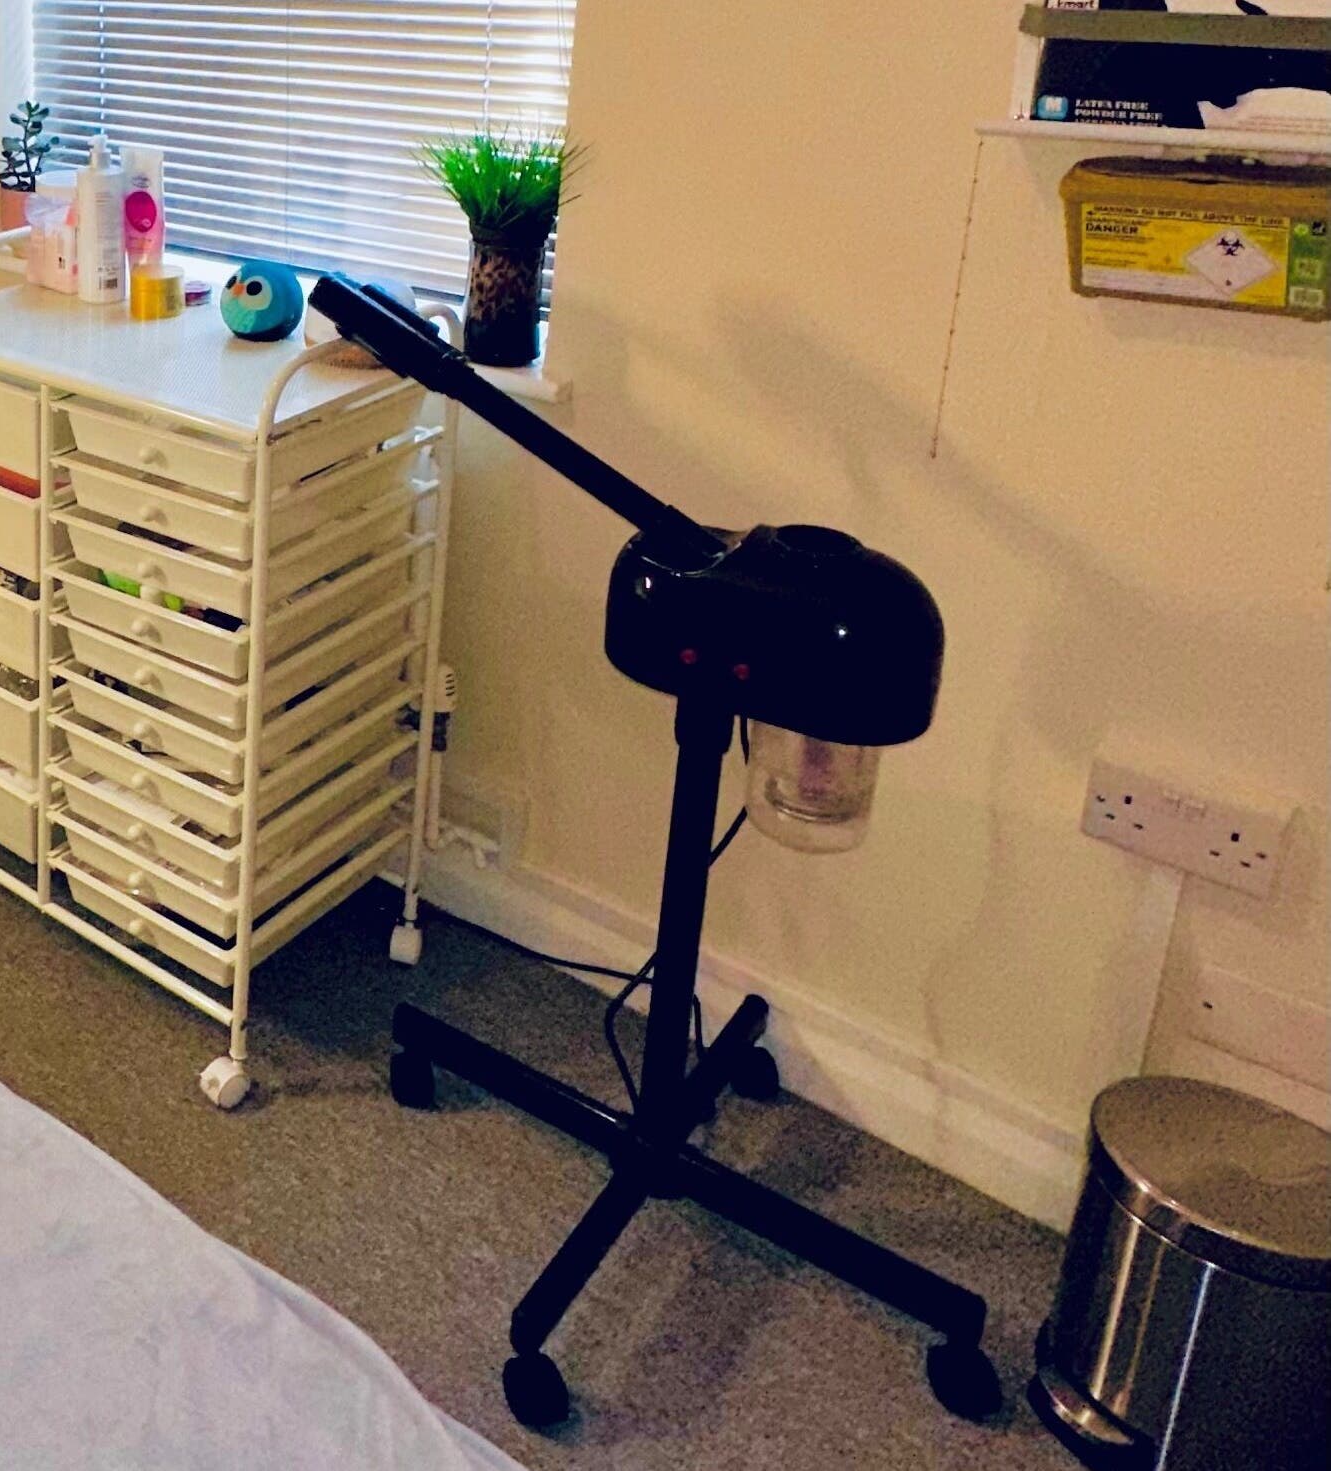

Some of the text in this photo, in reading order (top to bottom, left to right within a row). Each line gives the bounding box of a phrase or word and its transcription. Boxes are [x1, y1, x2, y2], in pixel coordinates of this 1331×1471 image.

[1075, 99, 1149, 111] LATEX FREE
[1074, 109, 1163, 120] POWDER FREE
[1085, 222, 1139, 234] DANGER
